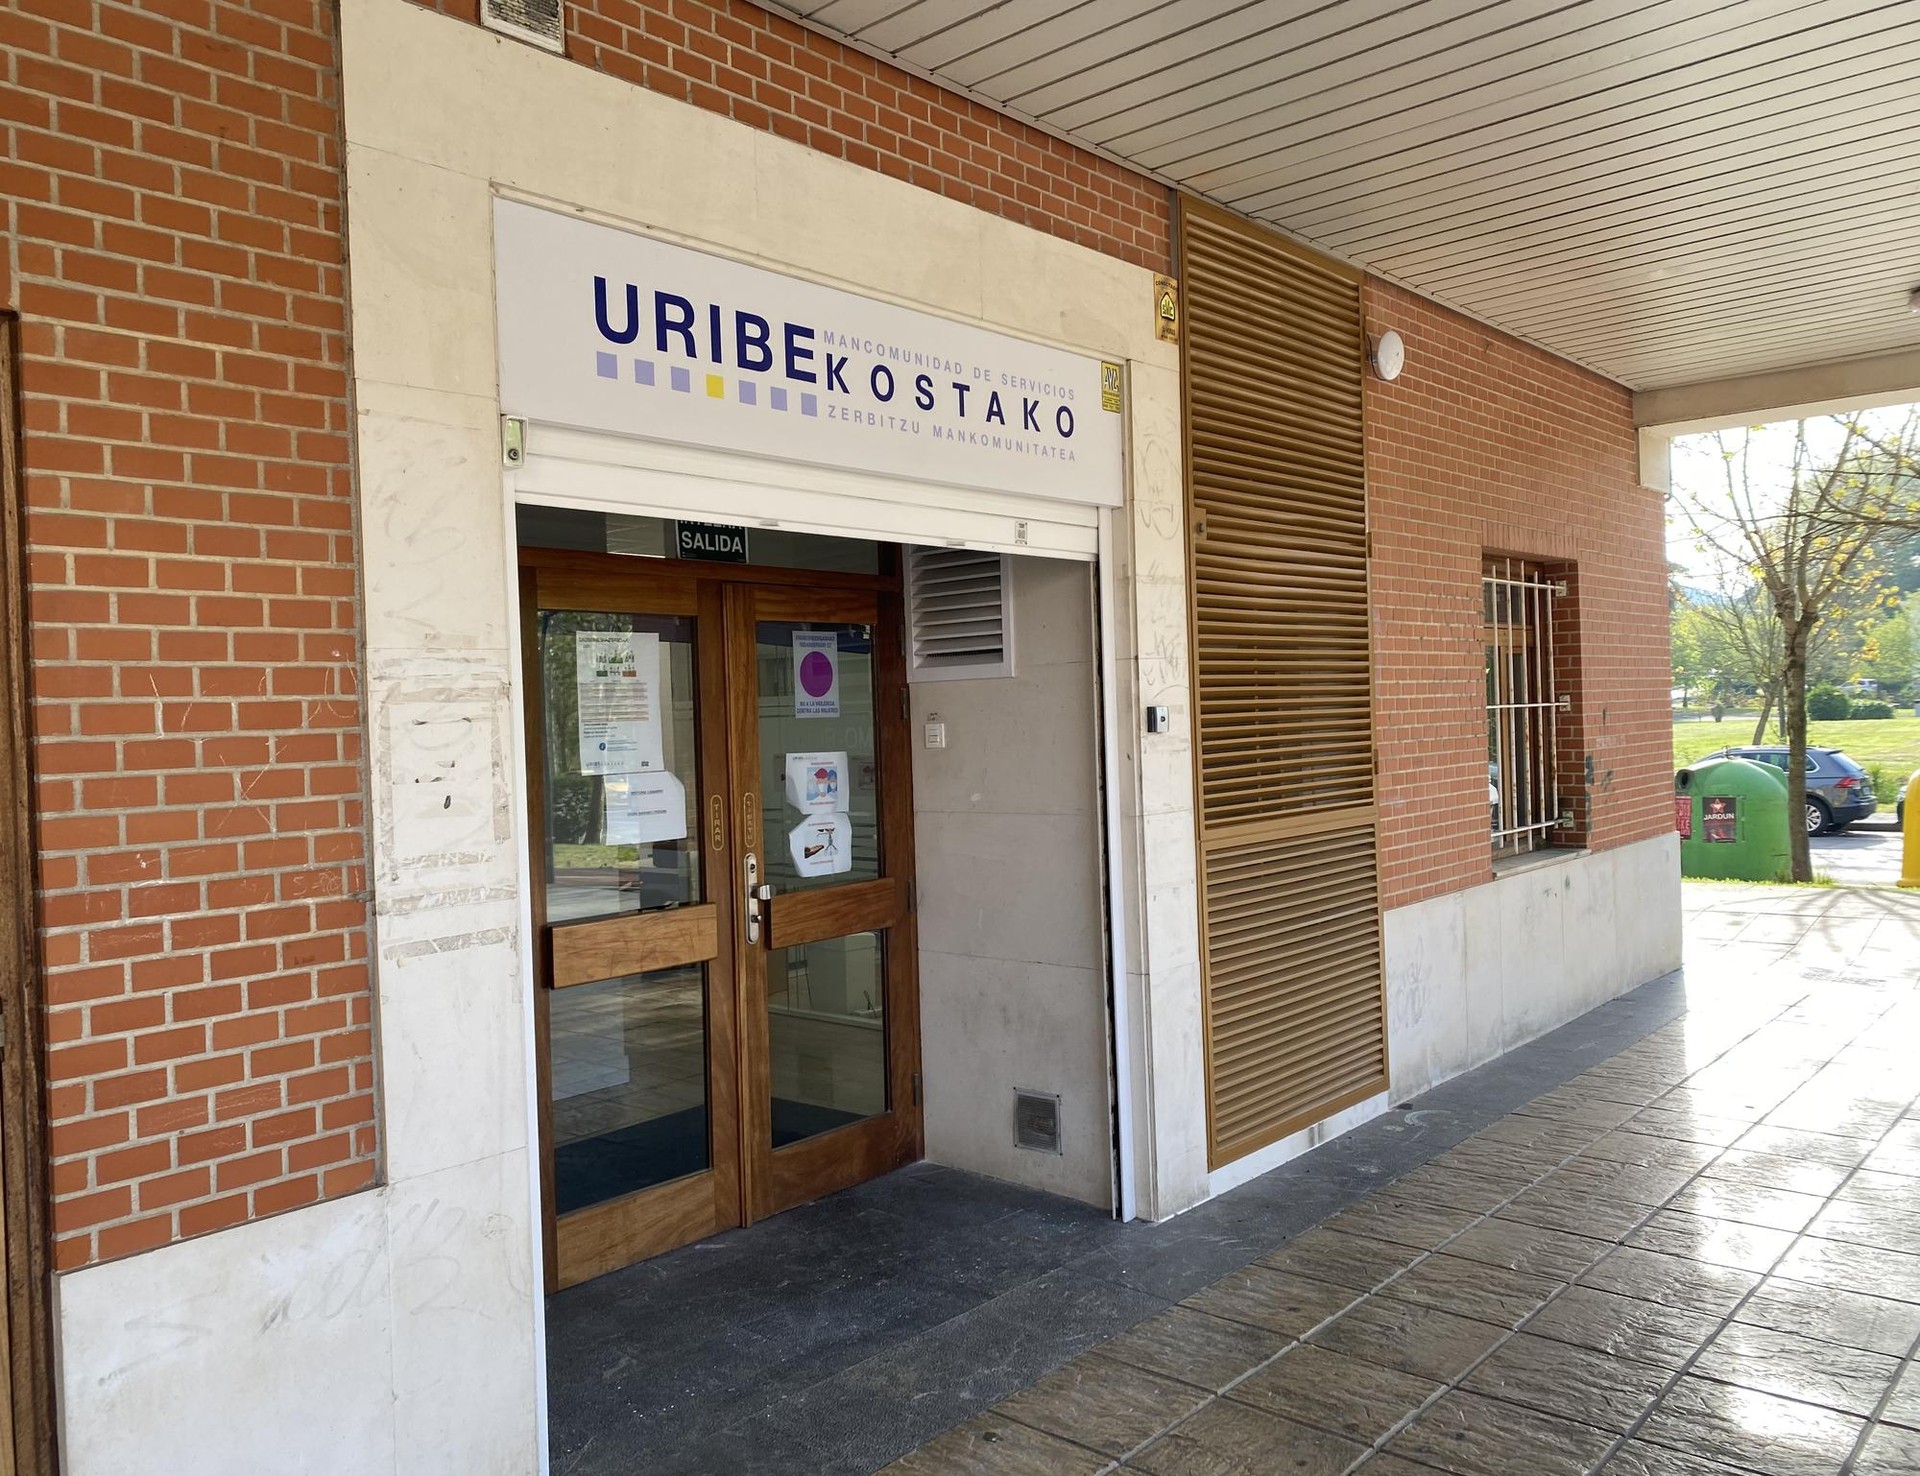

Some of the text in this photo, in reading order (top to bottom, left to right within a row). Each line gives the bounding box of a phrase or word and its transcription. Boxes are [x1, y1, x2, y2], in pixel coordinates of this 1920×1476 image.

[594, 275, 1075, 438] URIBE KOSTAKO
[824, 330, 1075, 400] MANCOMUNIDAD DE SERVICIOS
[827, 405, 1076, 462] ZERBITZU MANKOMUNITATEA
[681, 531, 743, 553] SALIDA
[713, 803, 721, 841] TIRAR
